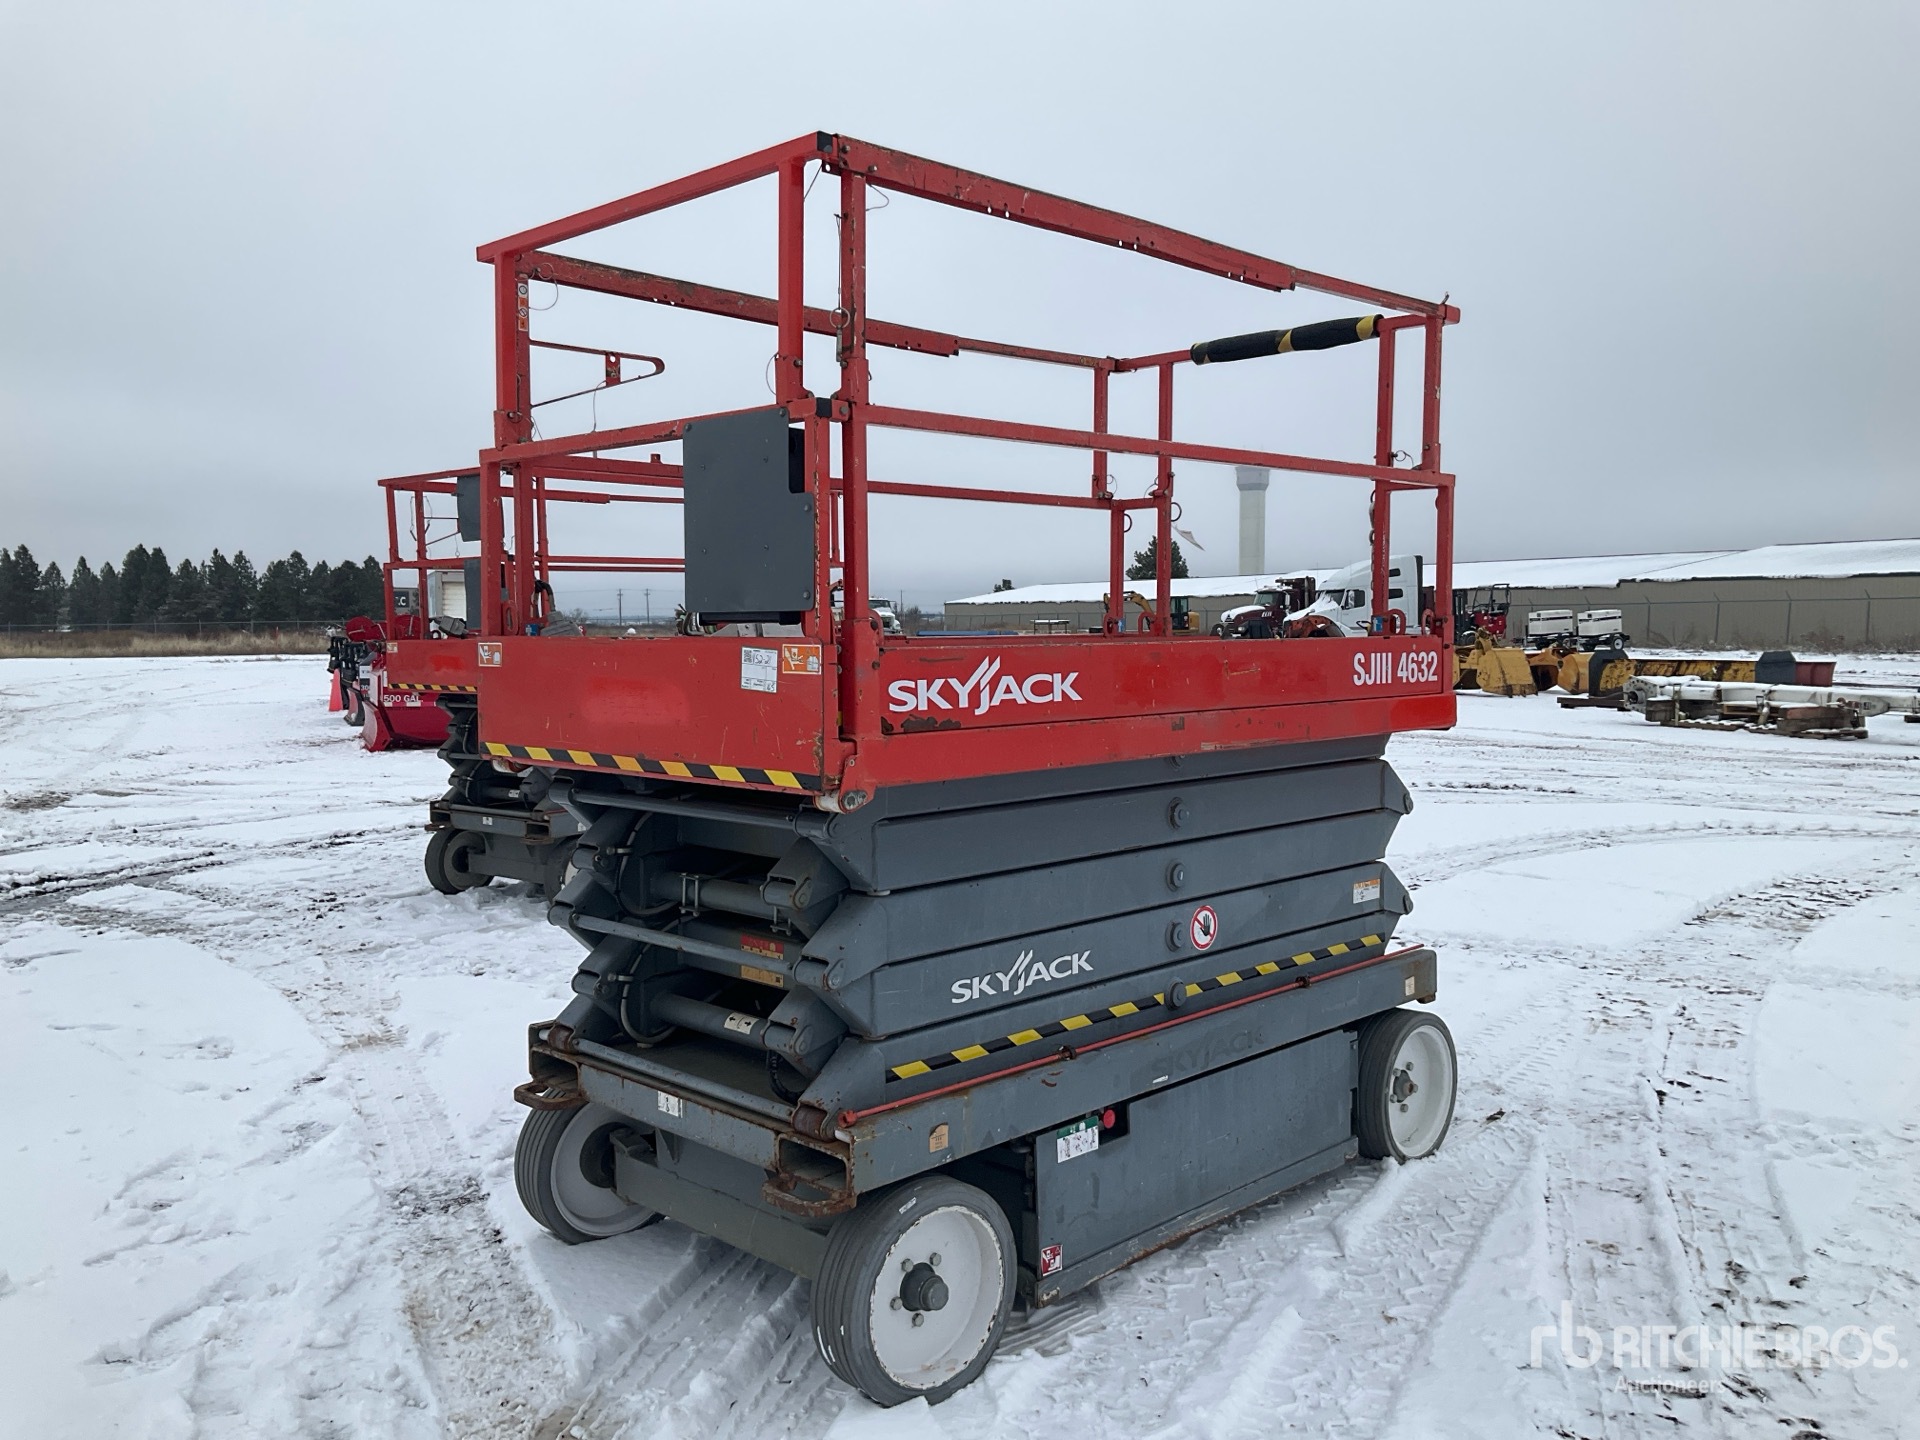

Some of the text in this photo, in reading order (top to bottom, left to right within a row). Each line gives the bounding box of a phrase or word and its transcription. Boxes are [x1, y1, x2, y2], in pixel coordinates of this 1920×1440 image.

[887, 655, 1083, 716] SKYJACK
[1353, 651, 1438, 686] SJIII 4632
[383, 694, 401, 702] 500
[951, 949, 1095, 1004] SKYJACK
